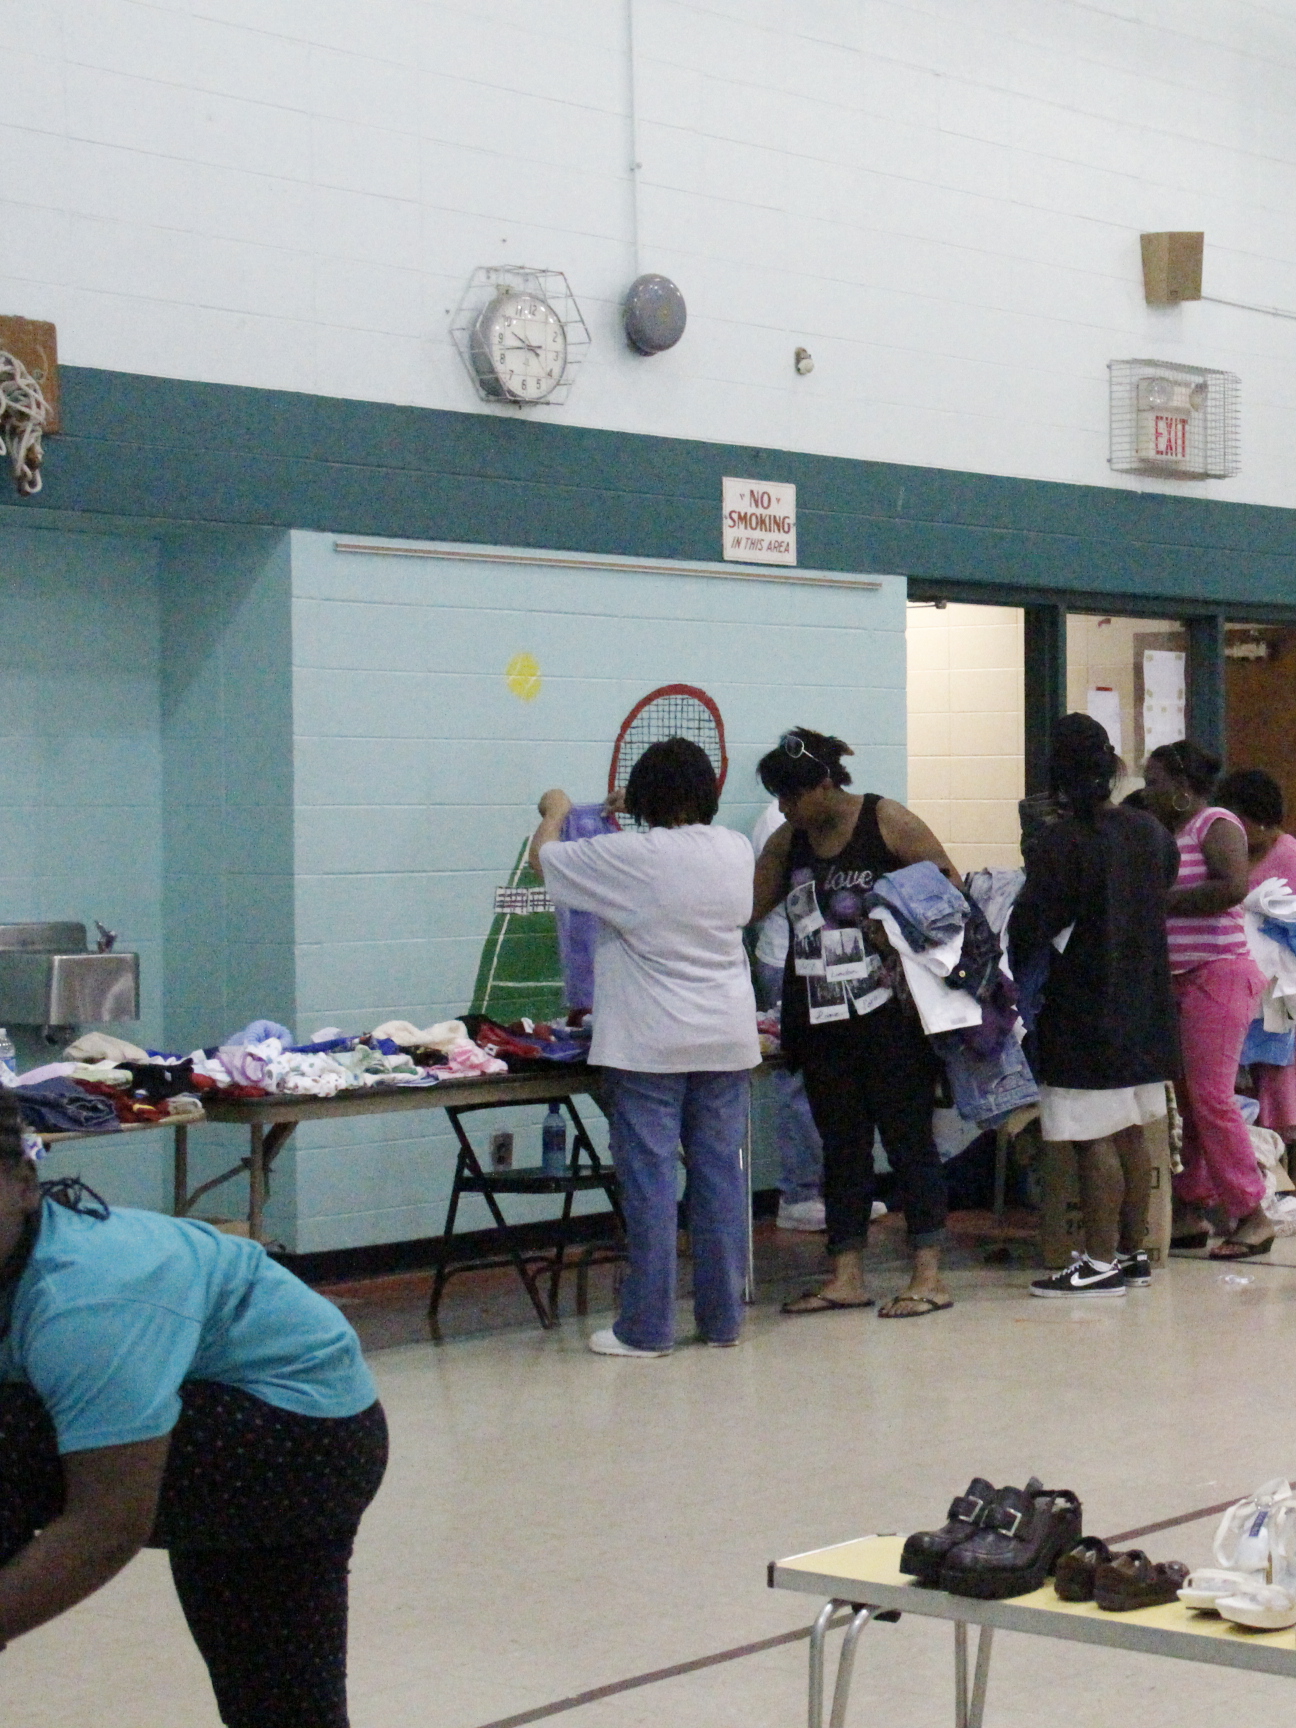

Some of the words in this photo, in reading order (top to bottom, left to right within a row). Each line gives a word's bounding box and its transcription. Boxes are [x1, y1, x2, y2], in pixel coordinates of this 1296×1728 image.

[529, 303, 538, 316] 12
[498, 332, 504, 344] 9
[552, 331, 558, 343] 2
[553, 350, 559, 361] 3
[508, 369, 514, 380] 7
[547, 368, 554, 378] 4
[521, 379, 527, 390] 6
[536, 378, 541, 390] 5
[1155, 415, 1189, 458] EXIT
[749, 489, 771, 510] NO
[728, 510, 791, 534] SMOKING
[731, 536, 742, 549] IN
[744, 537, 765, 551] THIS
[766, 540, 790, 553] AREA
